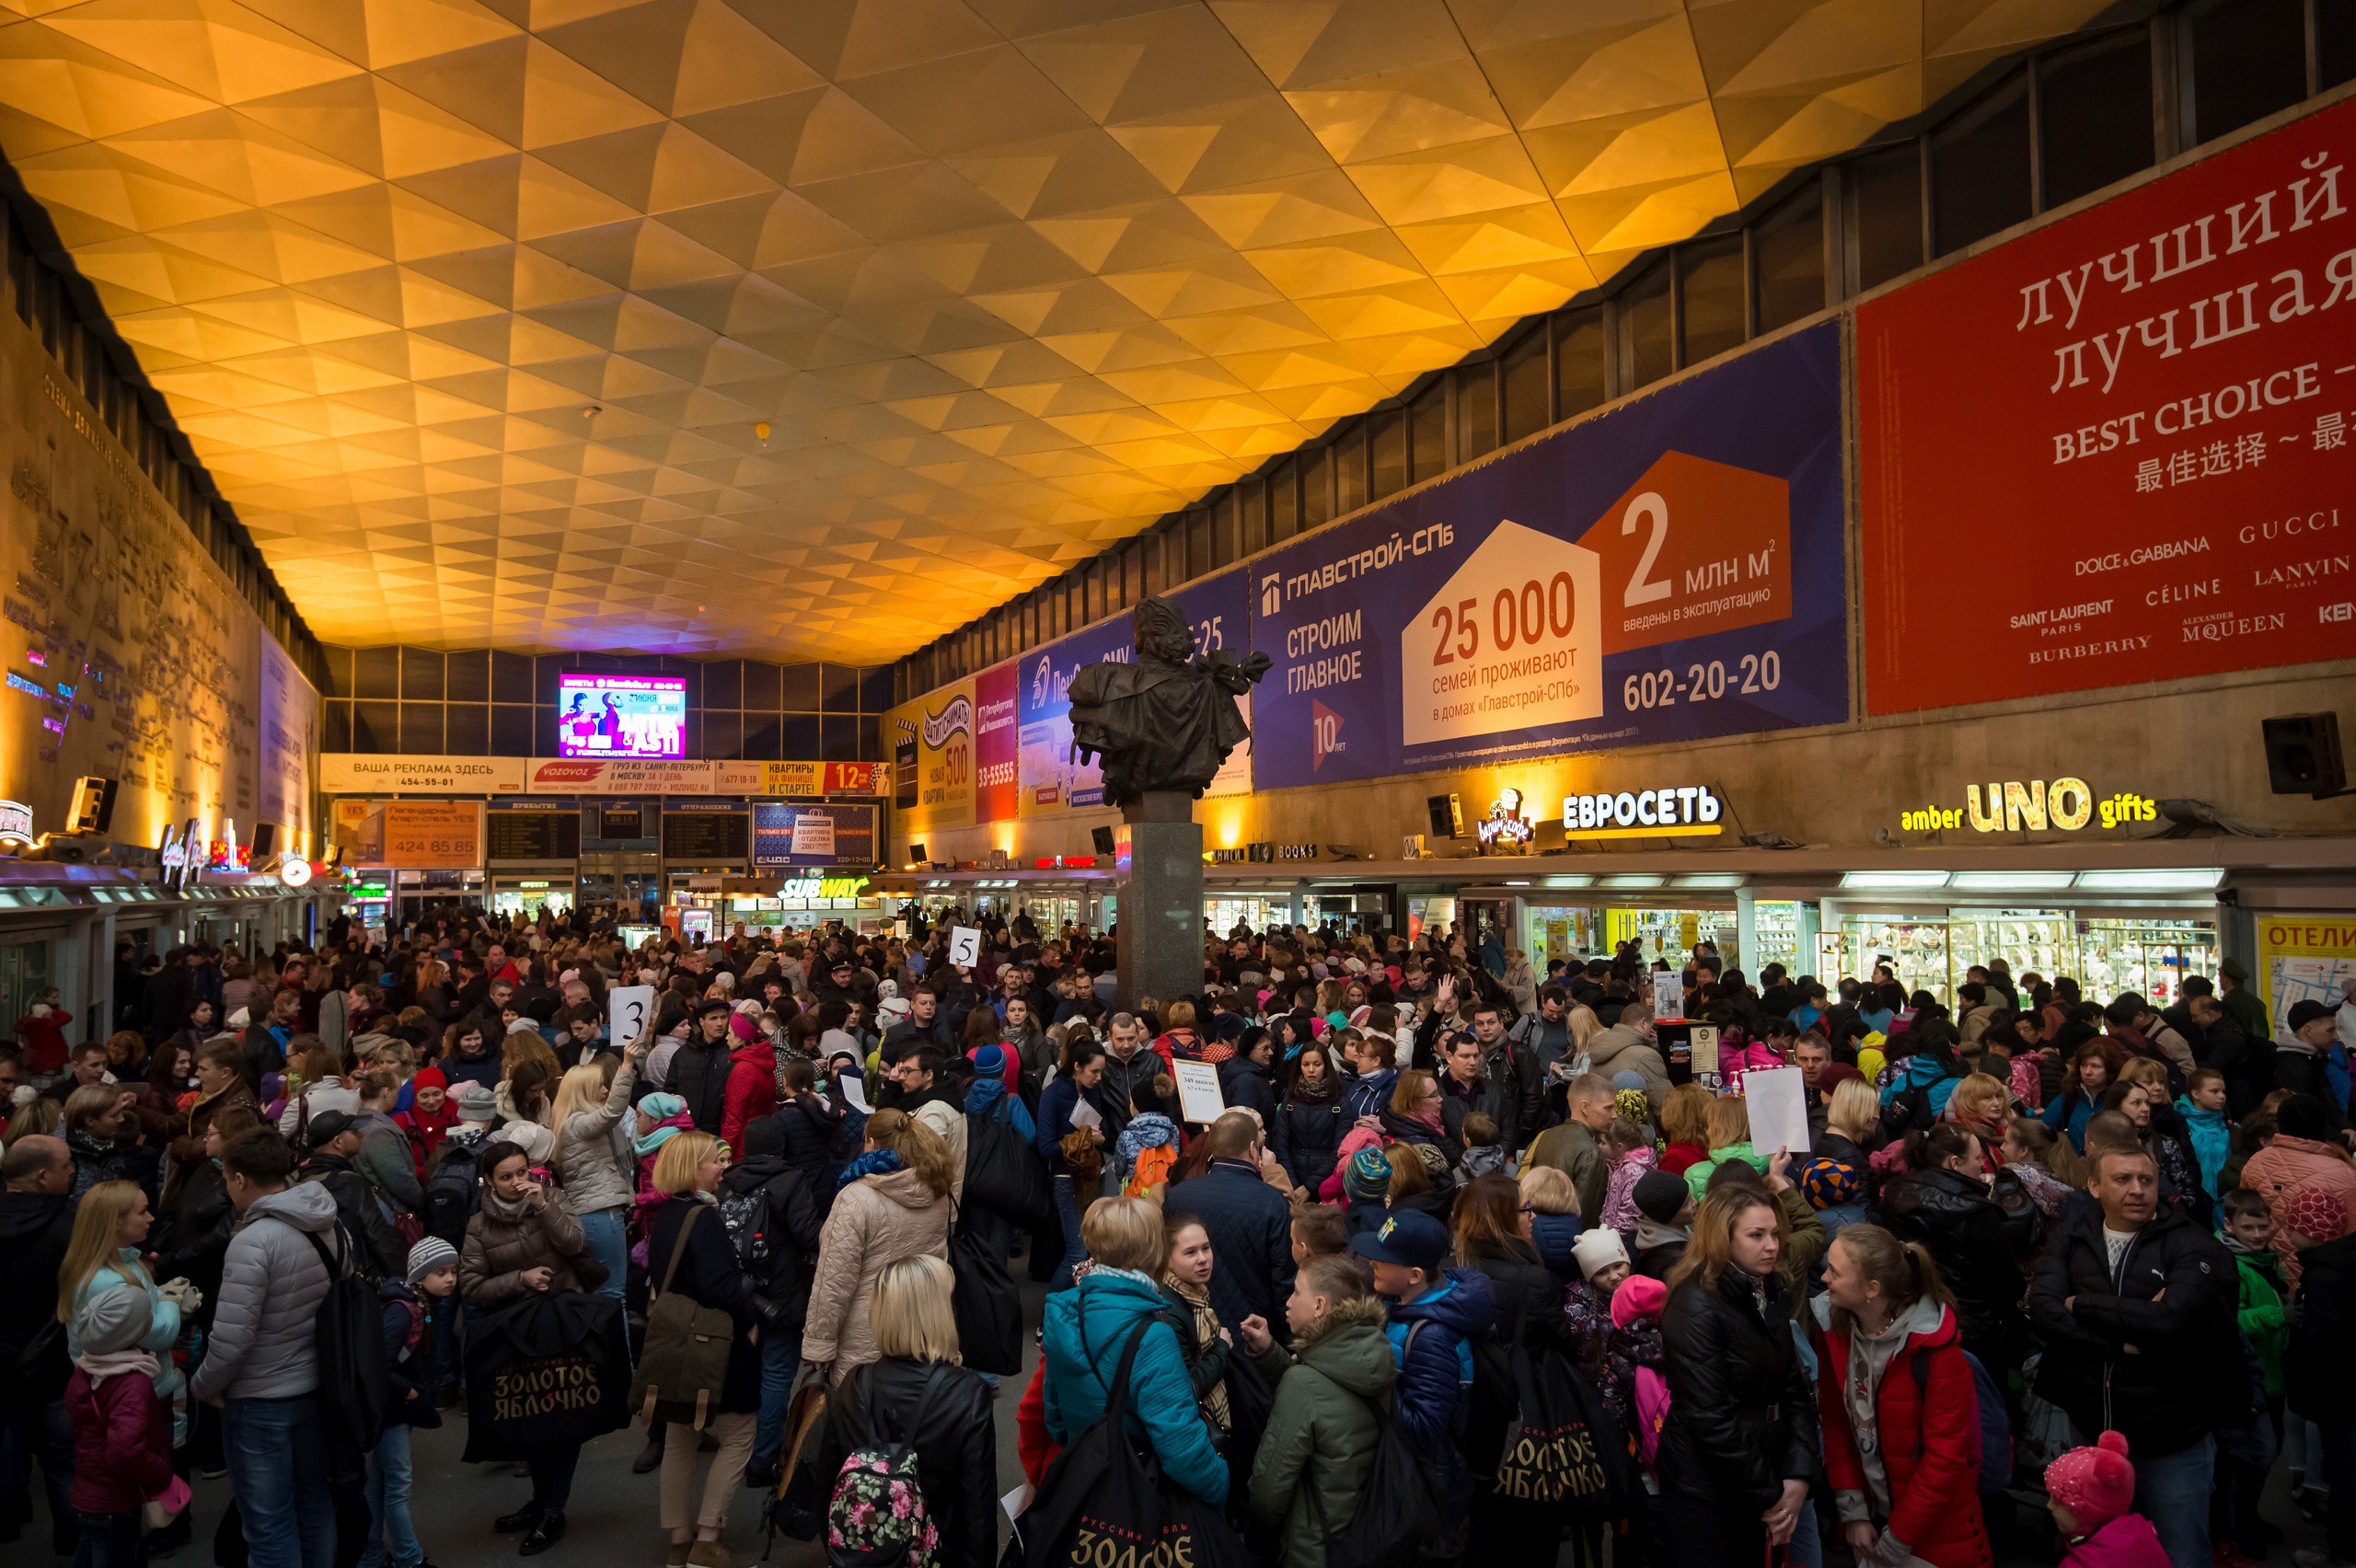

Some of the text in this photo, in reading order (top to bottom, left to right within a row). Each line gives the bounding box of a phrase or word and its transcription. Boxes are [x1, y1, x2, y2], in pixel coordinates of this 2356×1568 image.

[2015, 151, 2348, 331] лучший
[2052, 363, 2322, 465] BEST CHOICE
[2134, 431, 2268, 494] 最佳选择
[2238, 507, 2340, 545] GUCCI
[1621, 491, 1672, 608] 2
[2254, 554, 2352, 587] LANVIN
[2145, 577, 2222, 607] CÉLINE
[2285, 579, 2319, 591] PARIS
[1432, 571, 1576, 667] 25 000
[1623, 608, 1670, 633] введены
[1673, 607, 1680, 622] в
[2010, 599, 2114, 629] SAINT LAURENT
[2181, 610, 2235, 626] ALEXANDER
[1288, 608, 1362, 659] СТРОИМ
[2040, 622, 2083, 637] PARIS
[2028, 634, 2153, 664] BURBERRY
[1288, 651, 1362, 695] ГЛАВНОЕ
[1432, 648, 1577, 696] семей проживают
[1623, 650, 1781, 713] 602-20-20
[1433, 708, 1439, 721] в
[1442, 698, 1476, 722] домах
[1313, 715, 1346, 754] 10 лет
[353, 763, 494, 776] ВАША РЕКЛАМА ЗДЕСЬ
[543, 767, 590, 776] VOZOVOZ
[610, 772, 616, 780] В
[617, 772, 647, 780] МОСКВУ
[647, 772, 656, 780] ЗА
[664, 773, 683, 781] ДЕНЬ
[612, 762, 629, 770] ГРУЗ
[644, 762, 710, 772] САНКТ-ПЕТЕРБУРГА
[768, 763, 814, 774] КВАРТИРЫ
[836, 763, 859, 790] 1,2
[930, 766, 945, 784] НОВАЯ
[946, 743, 968, 788] 500
[978, 760, 1014, 789] 33-55555
[400, 778, 455, 787] 454-55-01
[669, 783, 710, 792] VOZOVOZ.RU
[725, 775, 757, 784] 677-18-18
[768, 775, 814, 783] НА ФИНИШЕ
[768, 783, 814, 795] И СТАРТЕ!
[512, 801, 557, 810] ПРИБЫТИЕ
[680, 802, 733, 812] ОТПРАВЛЕНИЕ
[923, 787, 945, 806] КВАРТИРА
[1563, 785, 1721, 829] ЕВРОСЕТЬ
[1901, 777, 2158, 833] amber UNO gifts
[396, 840, 474, 852] 424 85 85
[1278, 845, 1314, 859] BOOKS
[767, 856, 791, 864] ЦДС
[780, 876, 868, 899] SUBWAY
[956, 937, 974, 962] 5
[2268, 926, 2356, 948] ОТЕЛИ
[622, 1000, 644, 1041] 3
[493, 1364, 598, 1398] ЗОЛОТОЕ
[493, 1383, 601, 1421] ЯБЛОЧКО
[1492, 1462, 1607, 1502] ЯБЛОЧКО
[1081, 1515, 1142, 1542] РУССКИЙ
